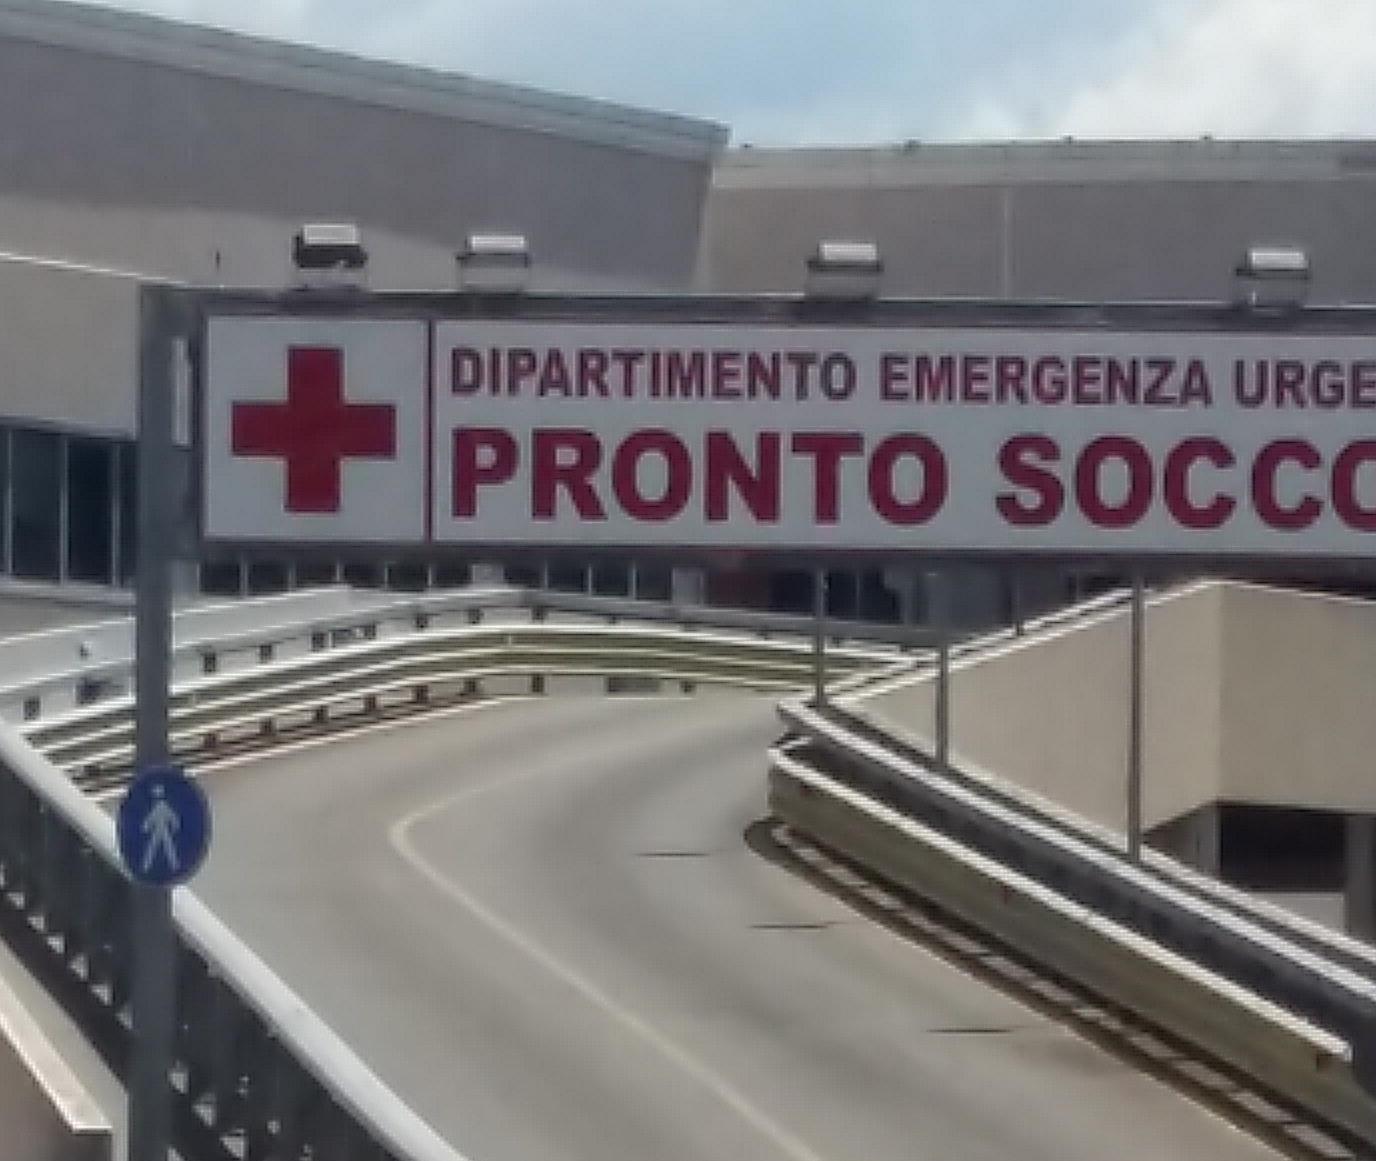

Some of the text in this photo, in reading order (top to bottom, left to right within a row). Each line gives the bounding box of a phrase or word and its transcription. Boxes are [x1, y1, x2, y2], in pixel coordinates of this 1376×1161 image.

[450, 346, 857, 402] DIPARTIMENTO
[879, 352, 1214, 408] EMERGENZA
[451, 424, 951, 527] PRONTO
